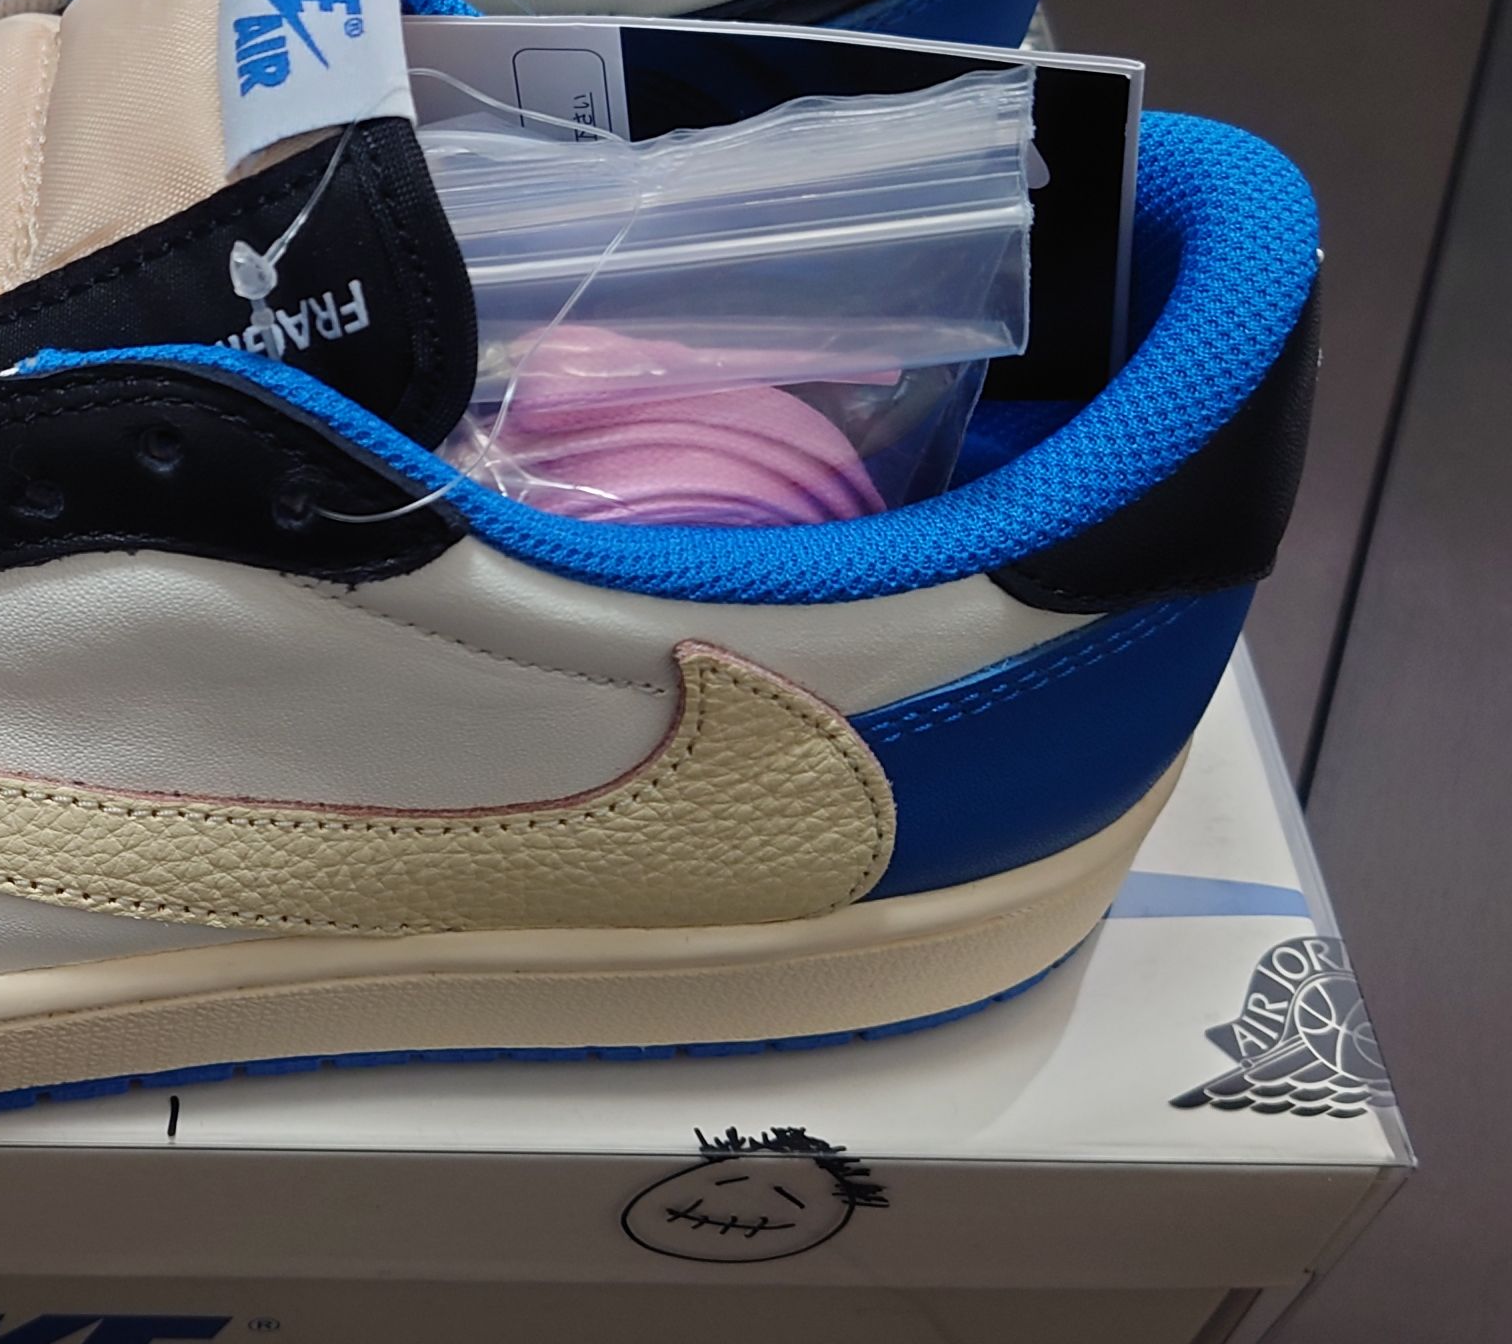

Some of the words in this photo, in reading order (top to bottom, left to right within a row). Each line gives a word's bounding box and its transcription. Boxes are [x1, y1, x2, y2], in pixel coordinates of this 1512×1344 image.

[233, 13, 291, 98] AIR
[215, 278, 370, 357] FRAG
[1231, 992, 1289, 1058] AIR
